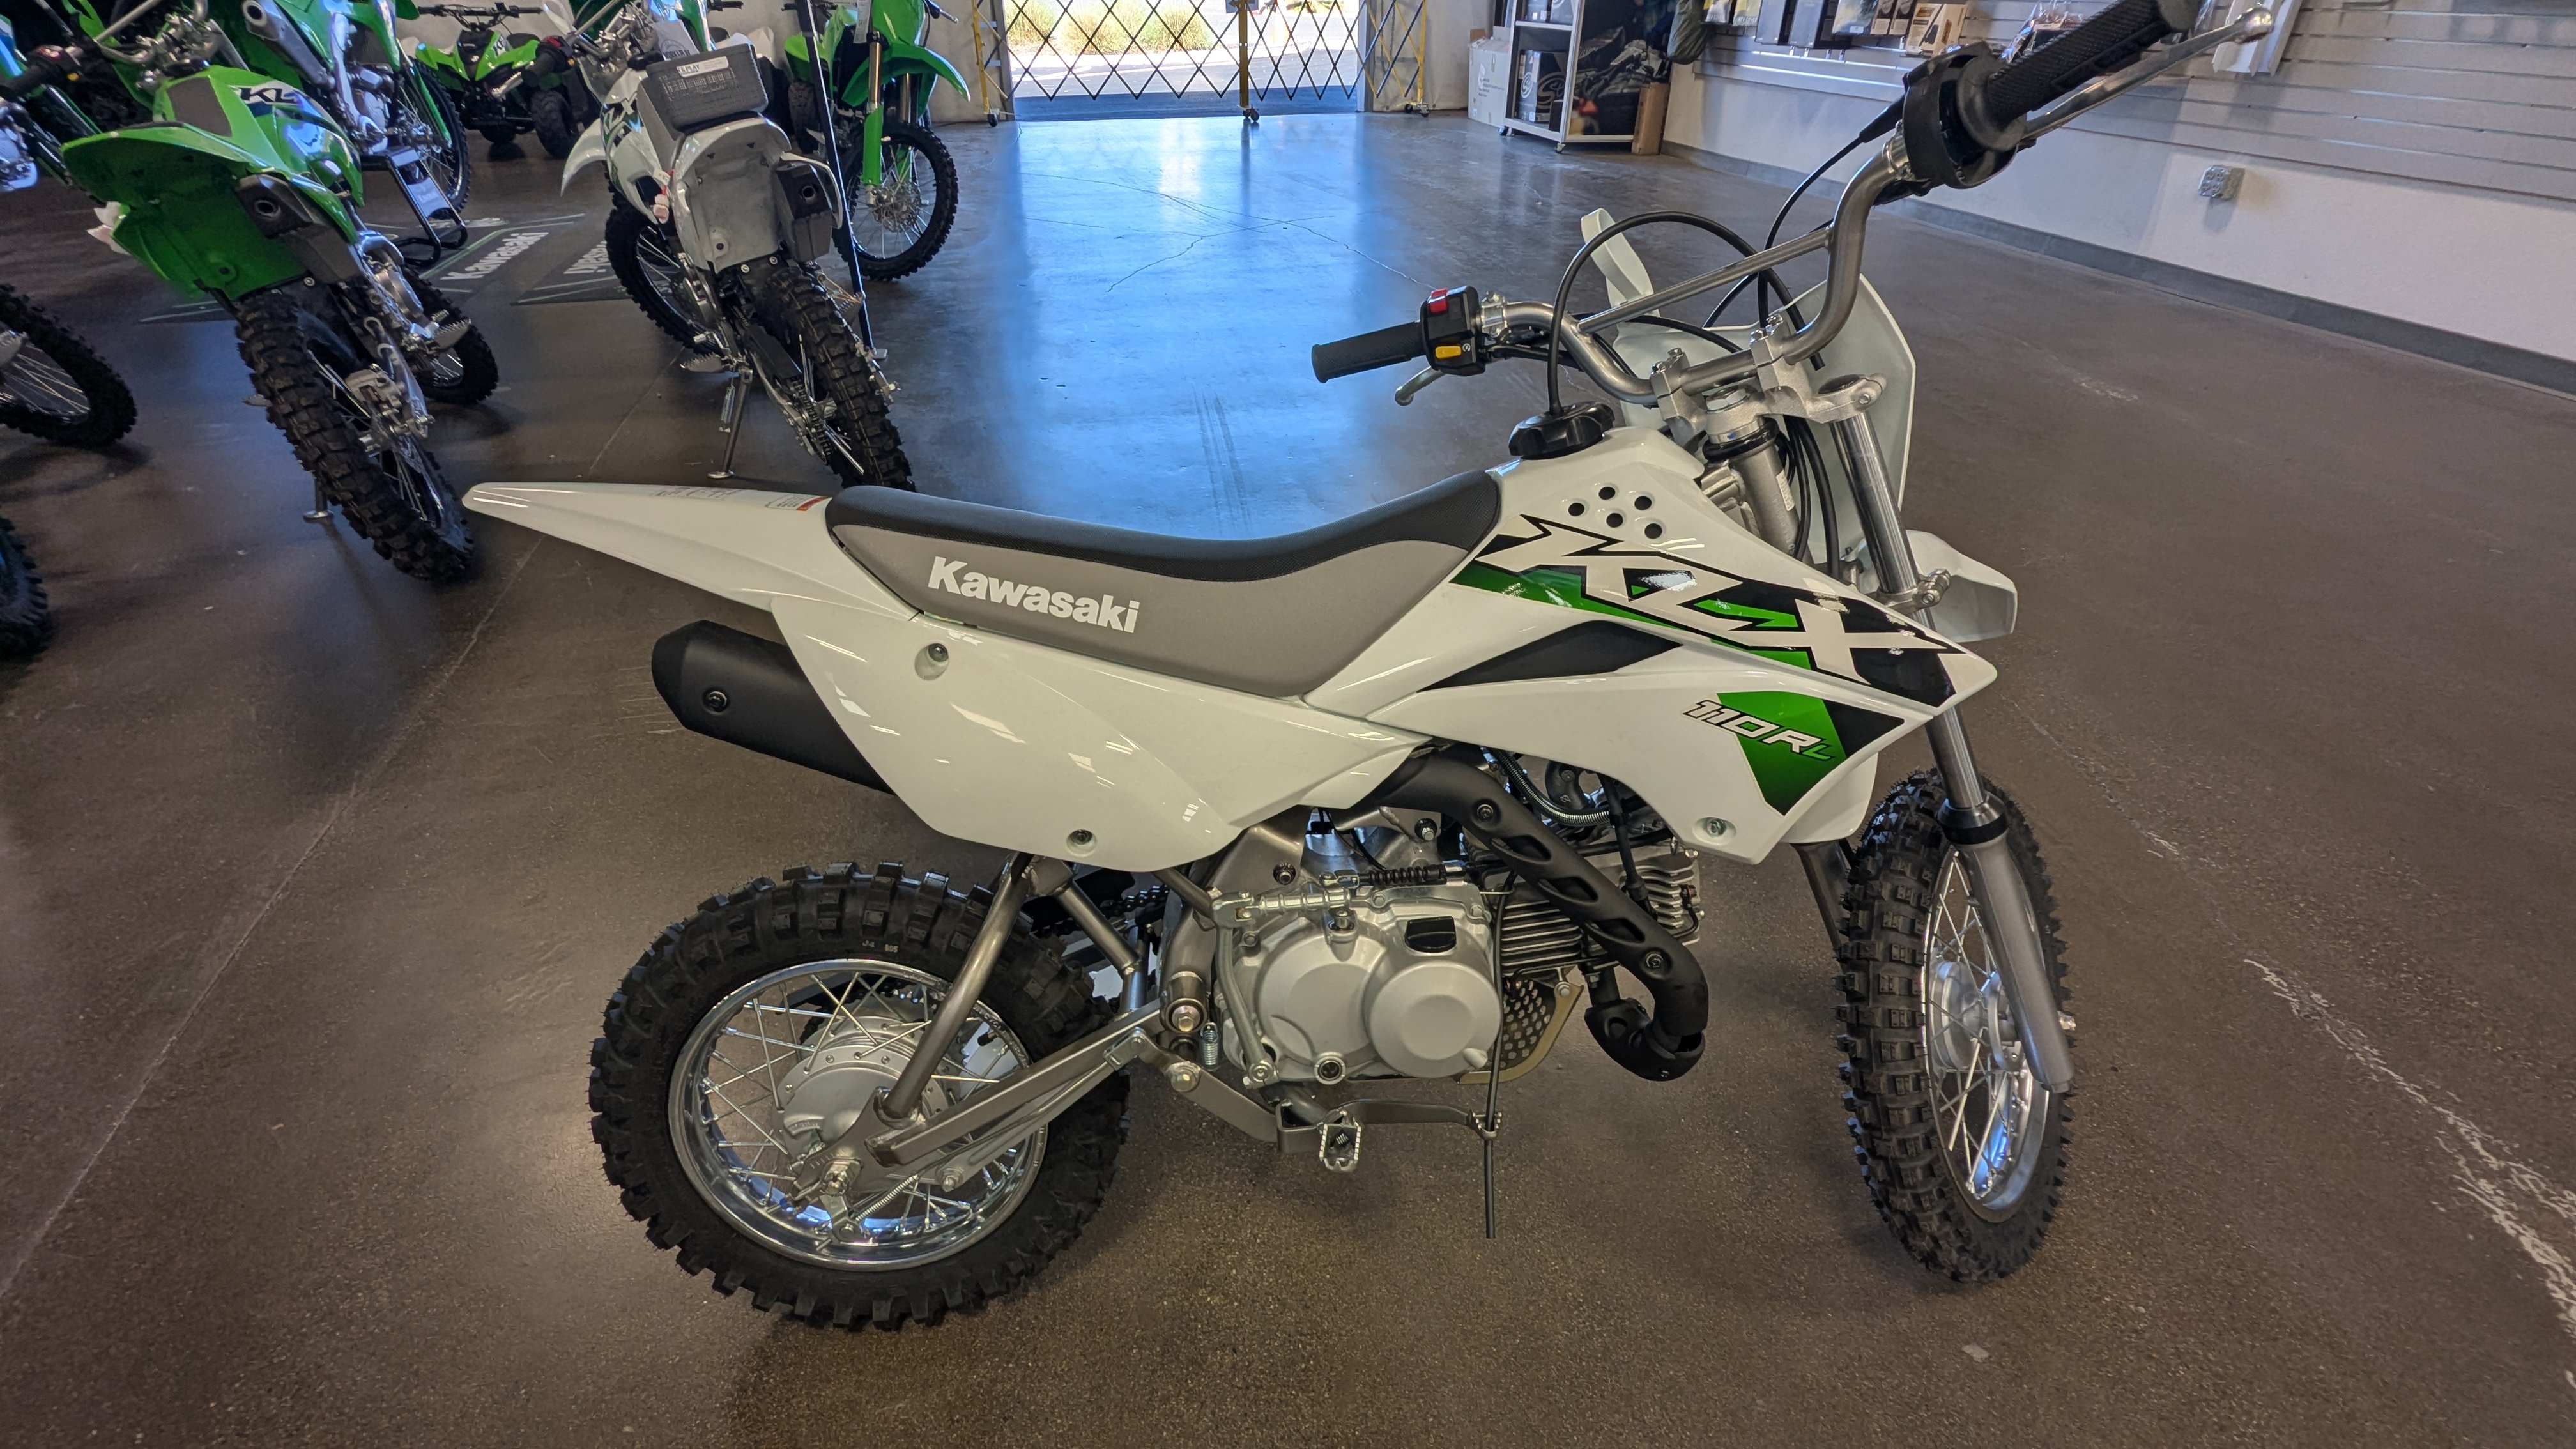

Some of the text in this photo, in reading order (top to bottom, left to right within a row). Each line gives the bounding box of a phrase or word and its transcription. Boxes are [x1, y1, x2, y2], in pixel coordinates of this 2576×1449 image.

[239, 88, 296, 104] KL
[440, 232, 549, 280] Kawasaki
[928, 556, 1140, 633] Kawasaki
[1475, 514, 1951, 686] KLX
